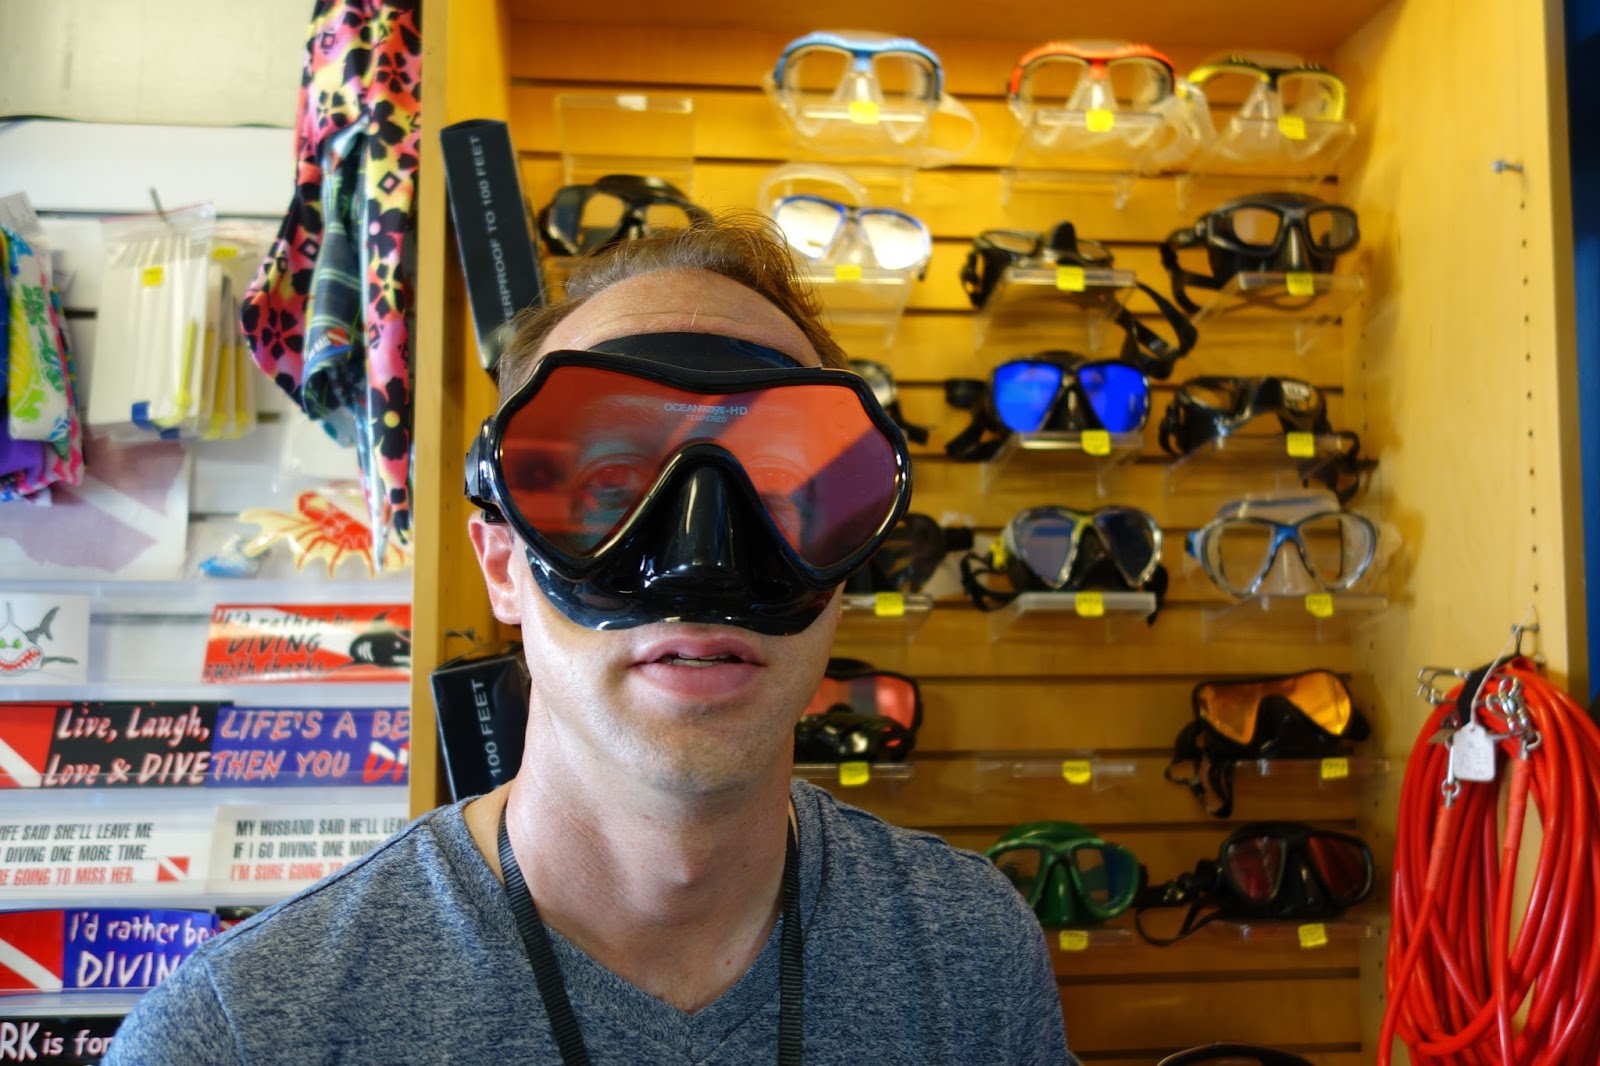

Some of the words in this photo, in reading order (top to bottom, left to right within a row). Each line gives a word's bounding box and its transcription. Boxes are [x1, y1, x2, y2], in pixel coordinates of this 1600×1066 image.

[470, 136, 487, 176] FEET
[480, 179, 493, 206] 100
[484, 212, 498, 233] TO
[491, 239, 514, 319] ERPROOF
[686, 414, 727, 423] TEMPERED
[227, 633, 322, 654] DIVING
[471, 679, 493, 735] FEET
[57, 706, 117, 743] Live,
[126, 705, 210, 747] Laugh,
[220, 710, 323, 741] LIFE'S
[333, 711, 357, 739] A
[44, 753, 100, 786] Love
[105, 757, 131, 785] &
[136, 751, 212, 785] DIVE
[212, 749, 286, 781] THEN
[297, 750, 350, 778] YOU
[485, 741, 502, 777] 100
[22, 825, 50, 840] SAID
[54, 824, 92, 840] SHE'LL
[97, 823, 132, 839] LEAVE
[135, 823, 154, 839] ME
[236, 819, 255, 837] MY
[260, 819, 315, 837] HUSBAND
[319, 818, 345, 835] SAID
[350, 818, 377, 834] HE'LL
[5, 846, 46, 863] DIVING
[50, 845, 75, 862] ONE
[78, 844, 113, 861] MORE
[233, 842, 244, 858] IF
[258, 842, 274, 858] GO
[279, 841, 317, 858] DIVING
[322, 840, 344, 857] ONE
[13, 868, 51, 885] GOING
[56, 867, 71, 884] TO
[75, 867, 107, 884] MISS
[231, 863, 249, 881] I'M
[254, 863, 284, 880] SURE
[288, 862, 324, 880] GOING
[69, 911, 99, 943] I'd
[107, 914, 180, 944] rather
[42, 1031, 63, 1056] is
[73, 1029, 113, 1057] for
